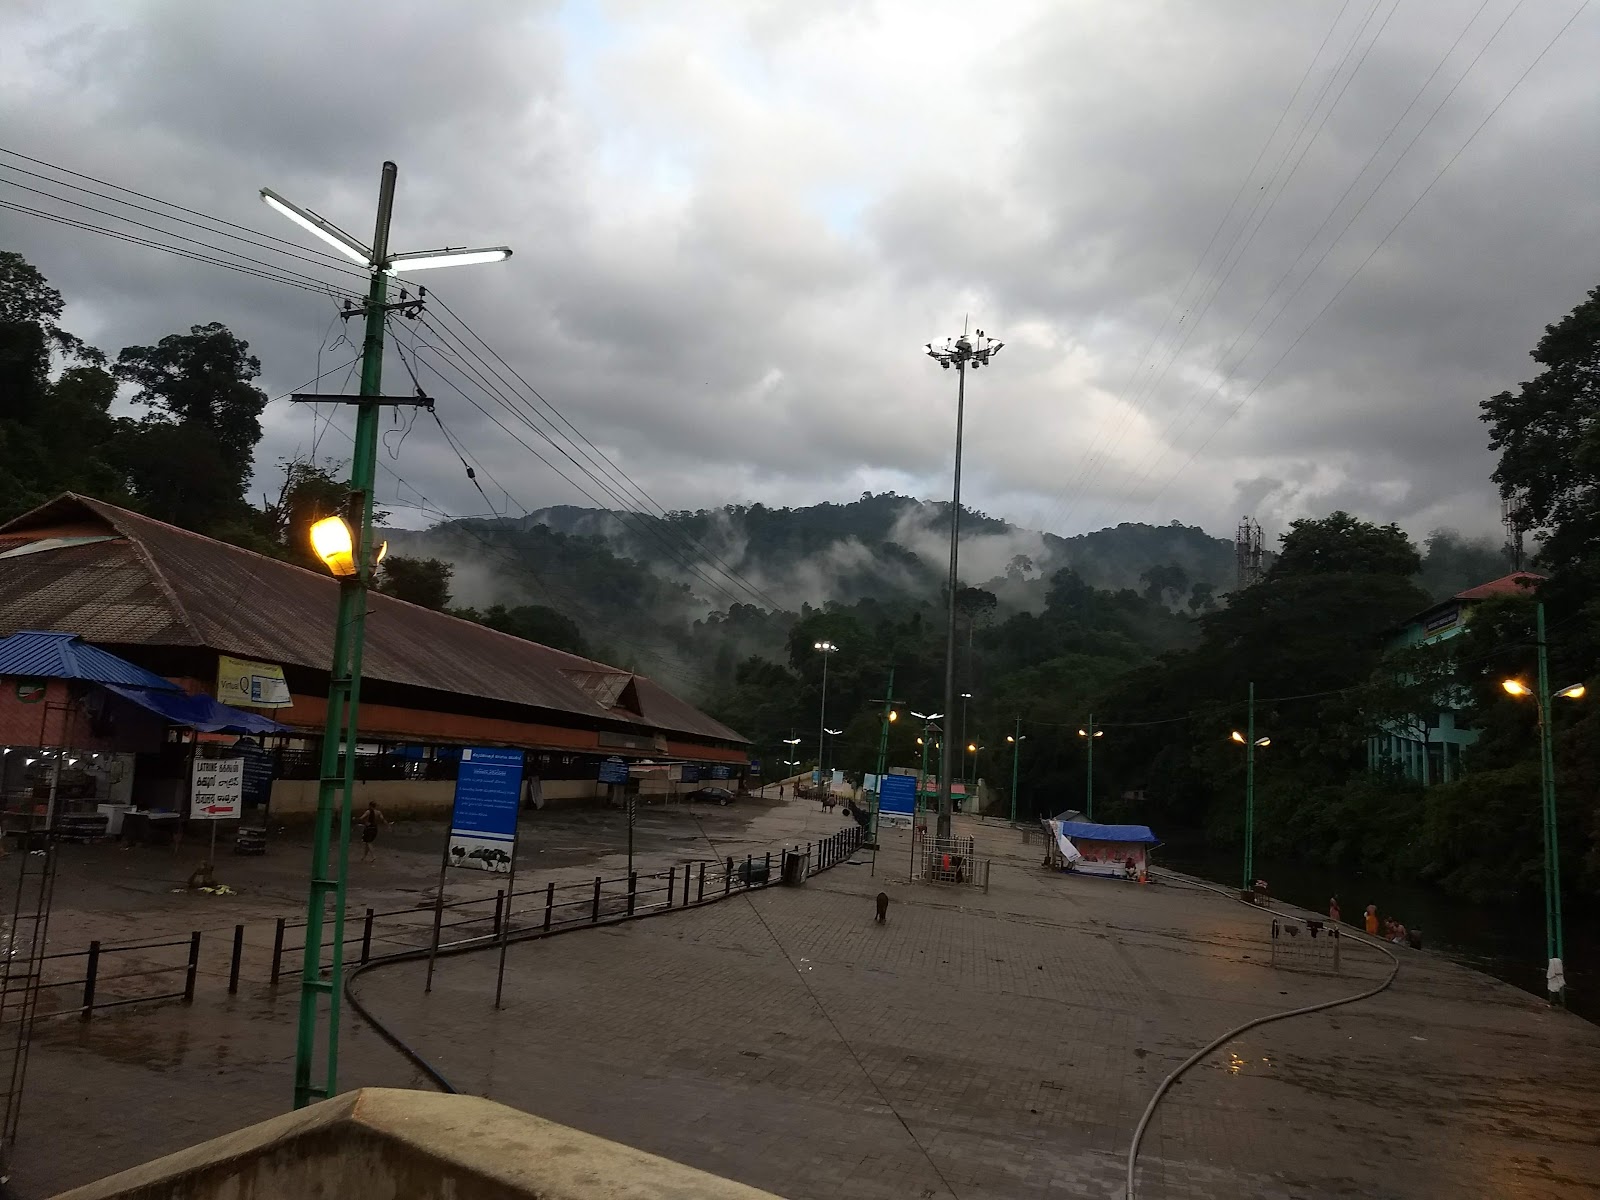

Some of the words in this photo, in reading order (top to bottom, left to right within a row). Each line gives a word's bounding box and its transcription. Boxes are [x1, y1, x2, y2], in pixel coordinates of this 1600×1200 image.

[221, 680, 239, 689] Virtual
[240, 677, 249, 694] Q
[197, 763, 218, 772] LATRINE
